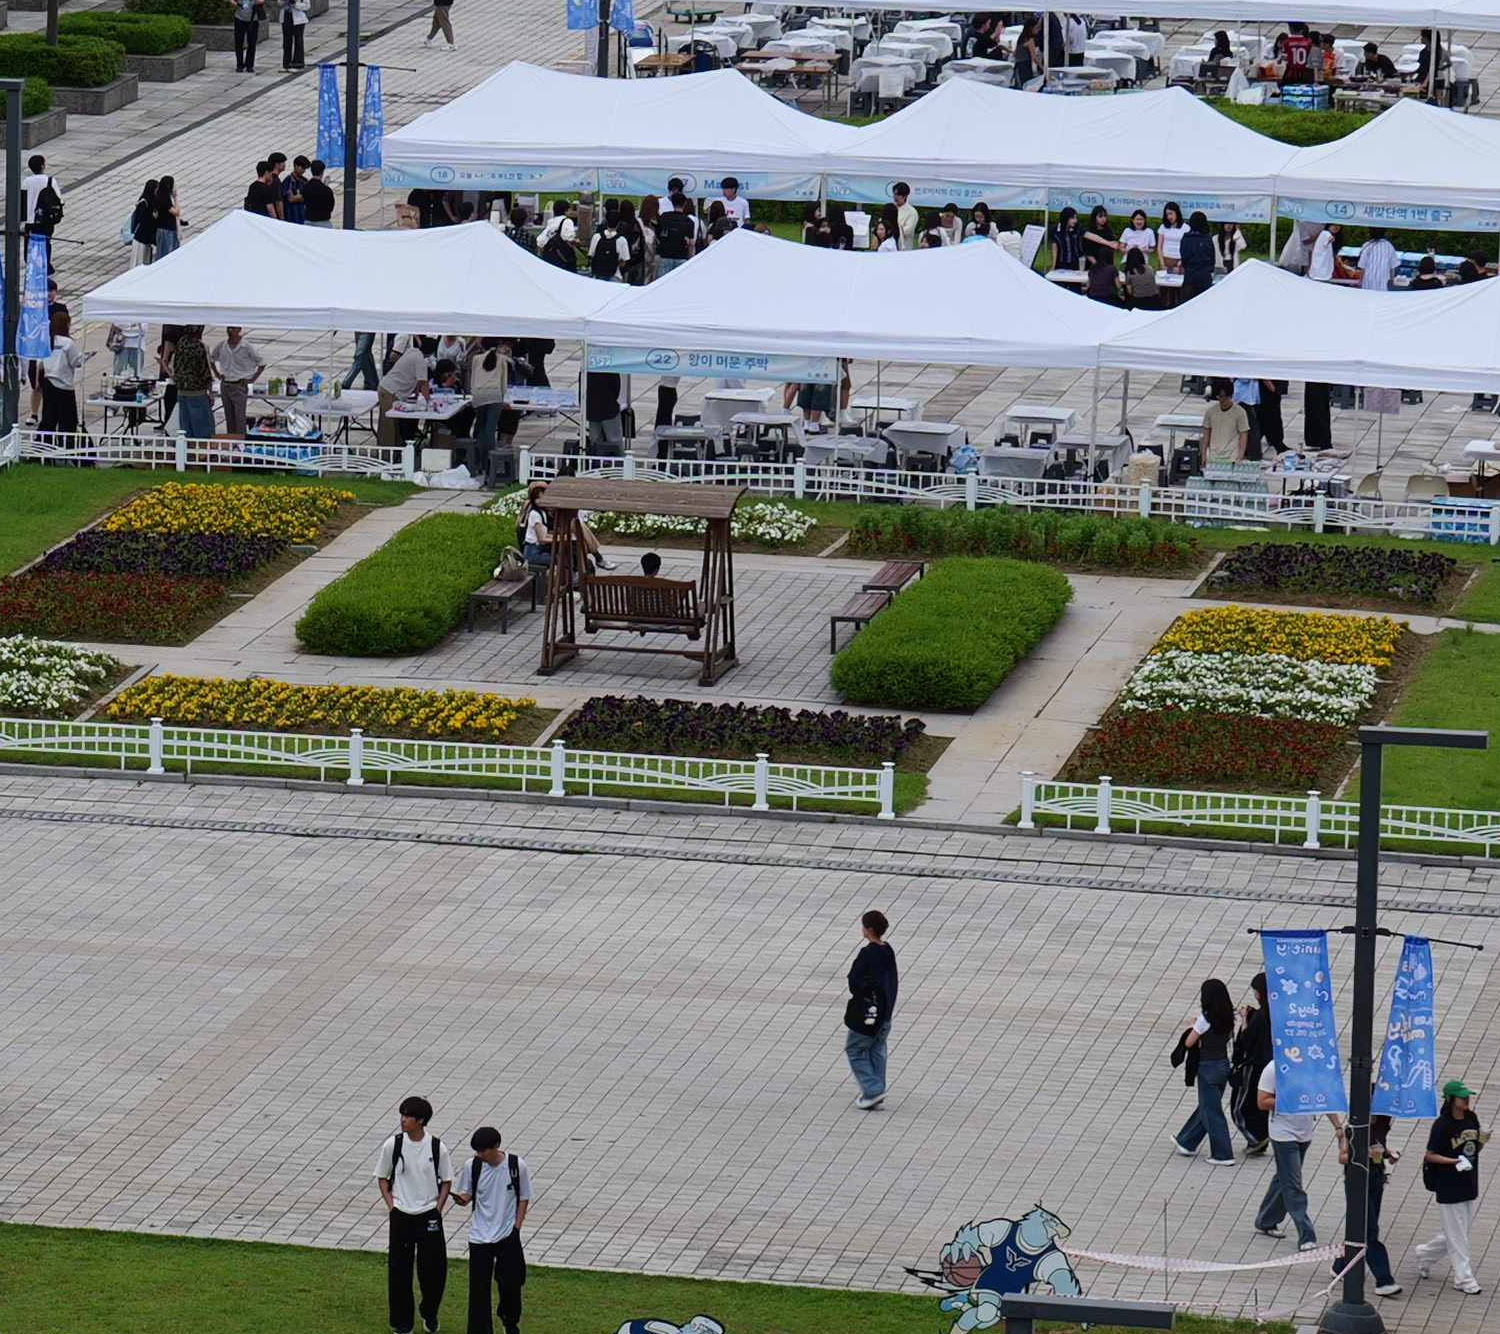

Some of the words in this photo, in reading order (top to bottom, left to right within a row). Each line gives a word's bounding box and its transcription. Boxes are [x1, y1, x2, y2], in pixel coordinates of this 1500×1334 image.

[1292, 47, 1307, 60] 10
[437, 170, 449, 179] 18
[1333, 205, 1348, 215] 14
[653, 354, 672, 364] 22
[689, 353, 712, 367] 왕이
[716, 355, 741, 369] 머문
[744, 357, 770, 371] 주막
